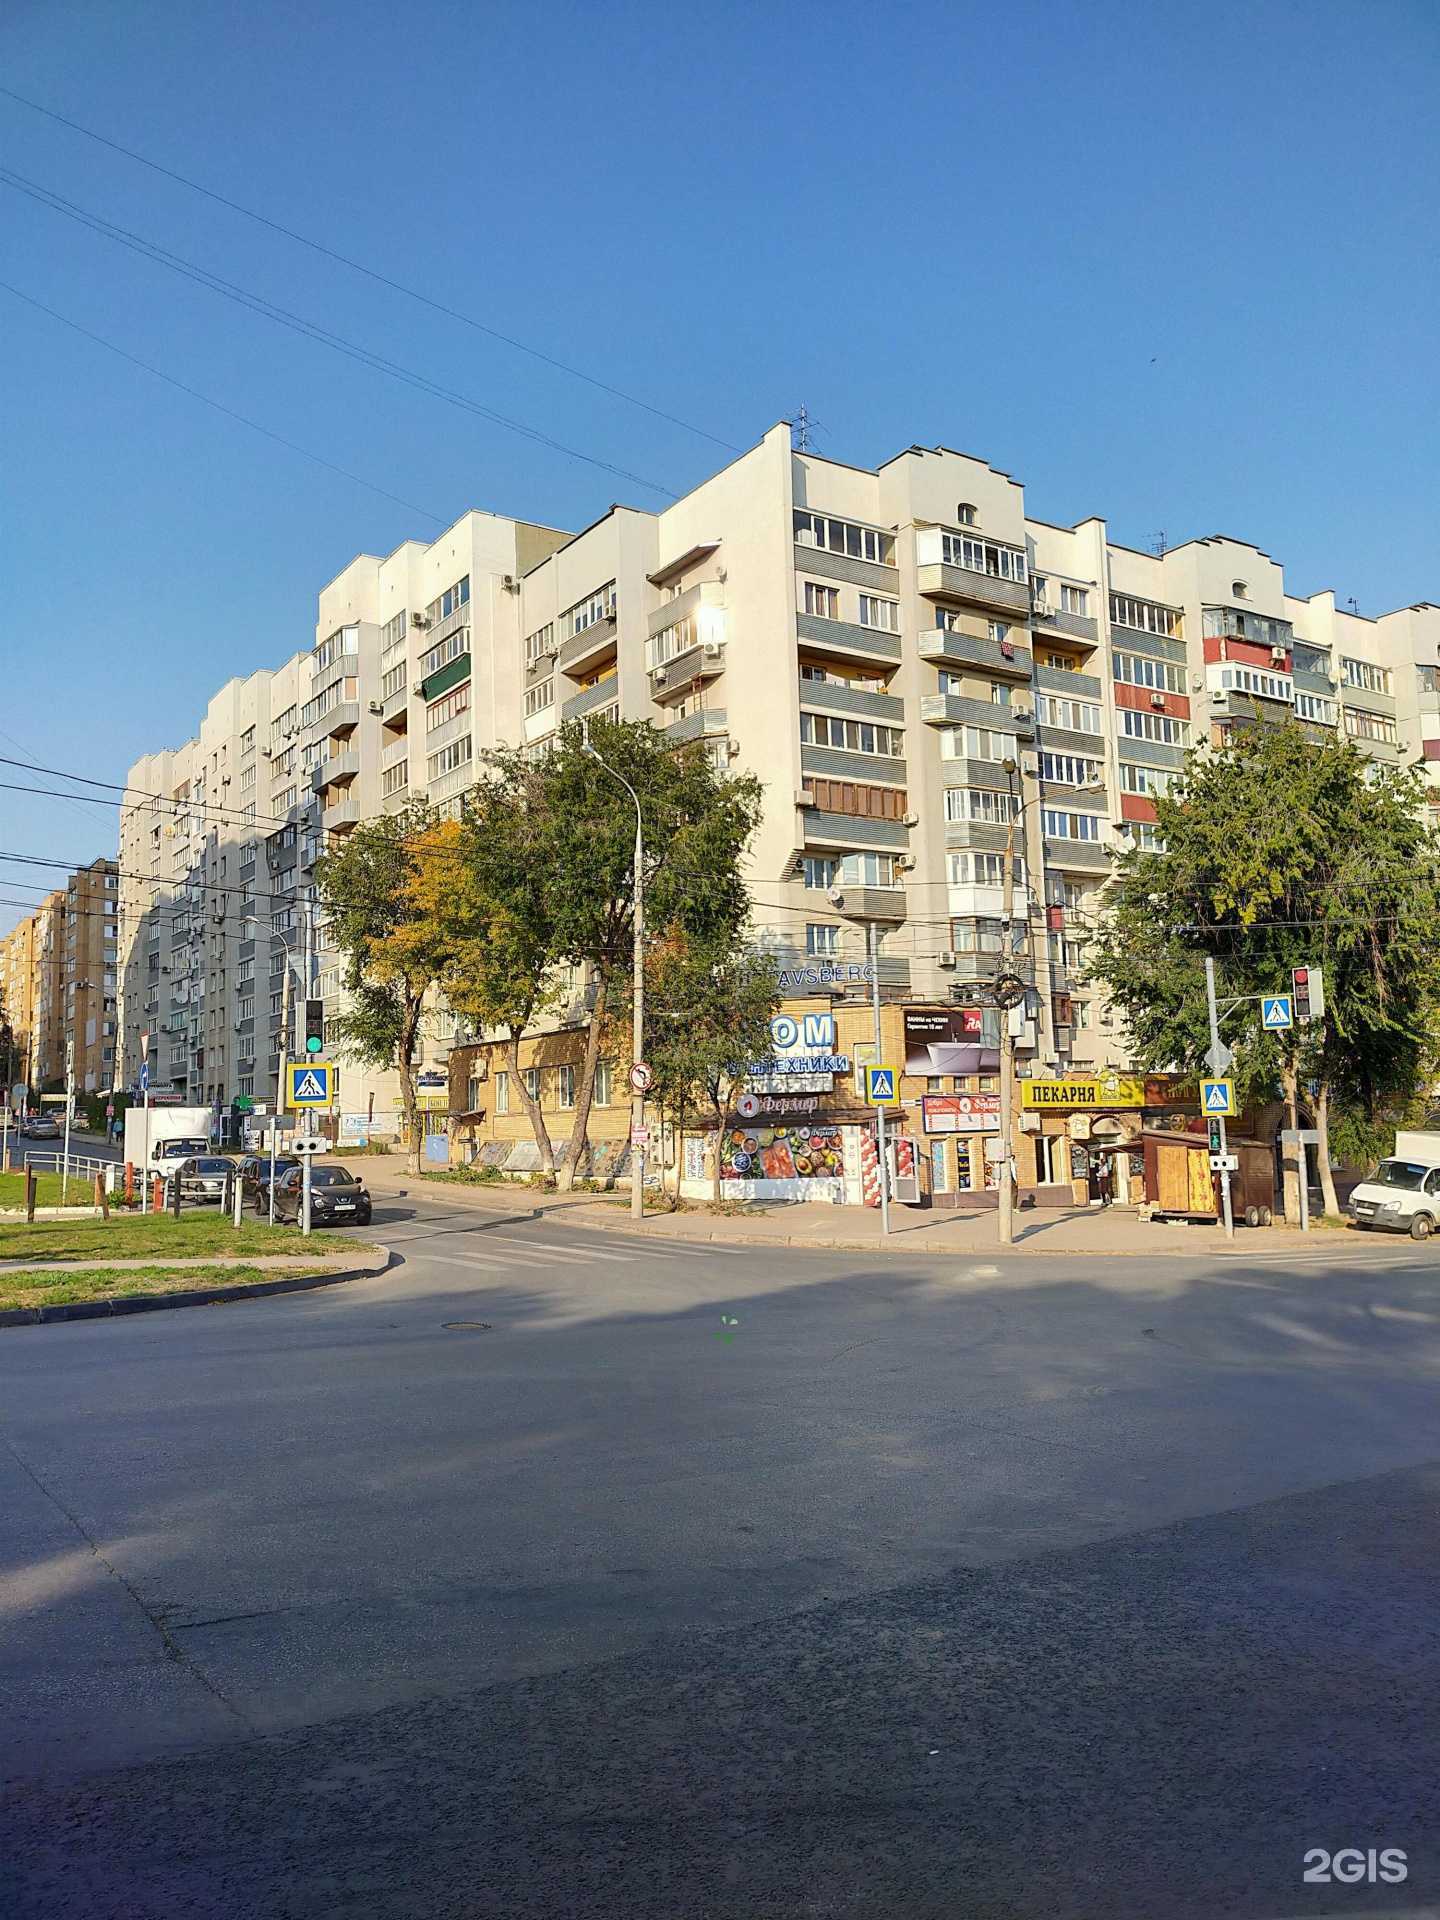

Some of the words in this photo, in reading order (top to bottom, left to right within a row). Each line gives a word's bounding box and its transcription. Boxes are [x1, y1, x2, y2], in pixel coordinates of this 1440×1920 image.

[776, 964, 875, 987] AVSBERG
[769, 1013, 835, 1049] ОМ
[966, 1017, 982, 1030] RA
[1032, 1086, 1096, 1103] ПЕКАРНЯ
